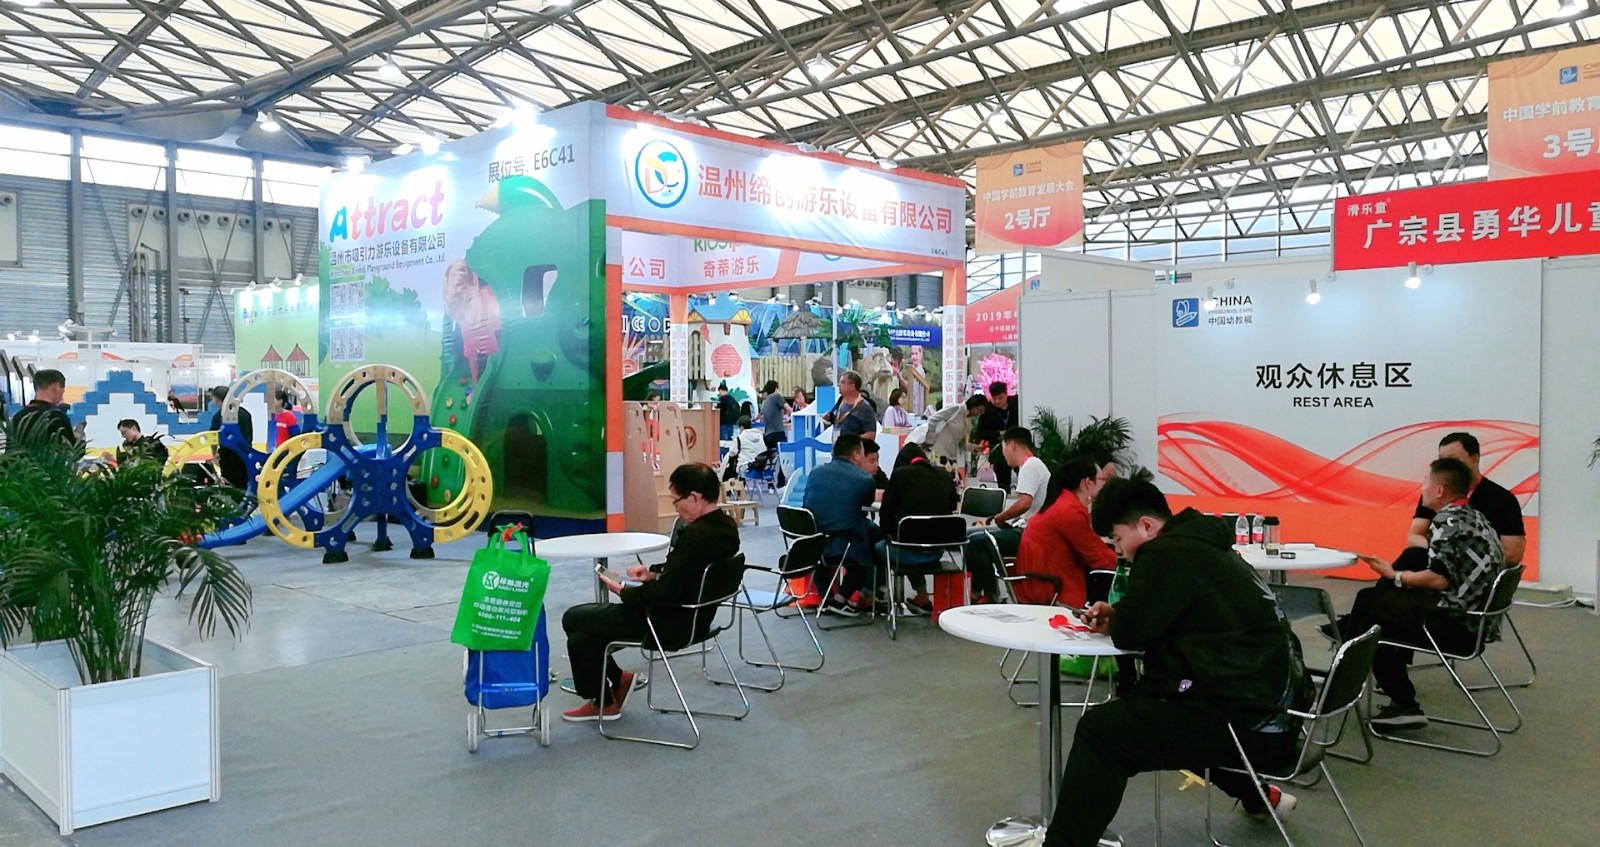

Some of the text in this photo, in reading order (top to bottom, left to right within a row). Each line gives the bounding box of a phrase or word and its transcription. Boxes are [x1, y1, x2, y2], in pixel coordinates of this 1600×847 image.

[1543, 127, 1600, 158] 3号
[534, 144, 575, 171] E6C41
[329, 180, 445, 243] Attract
[1004, 206, 1051, 230] 2号厅
[622, 256, 665, 280] 公司
[704, 255, 759, 278] 奇蒂游乐
[1256, 361, 1412, 390] 观众休息区
[1293, 397, 1374, 408] REST AREA
